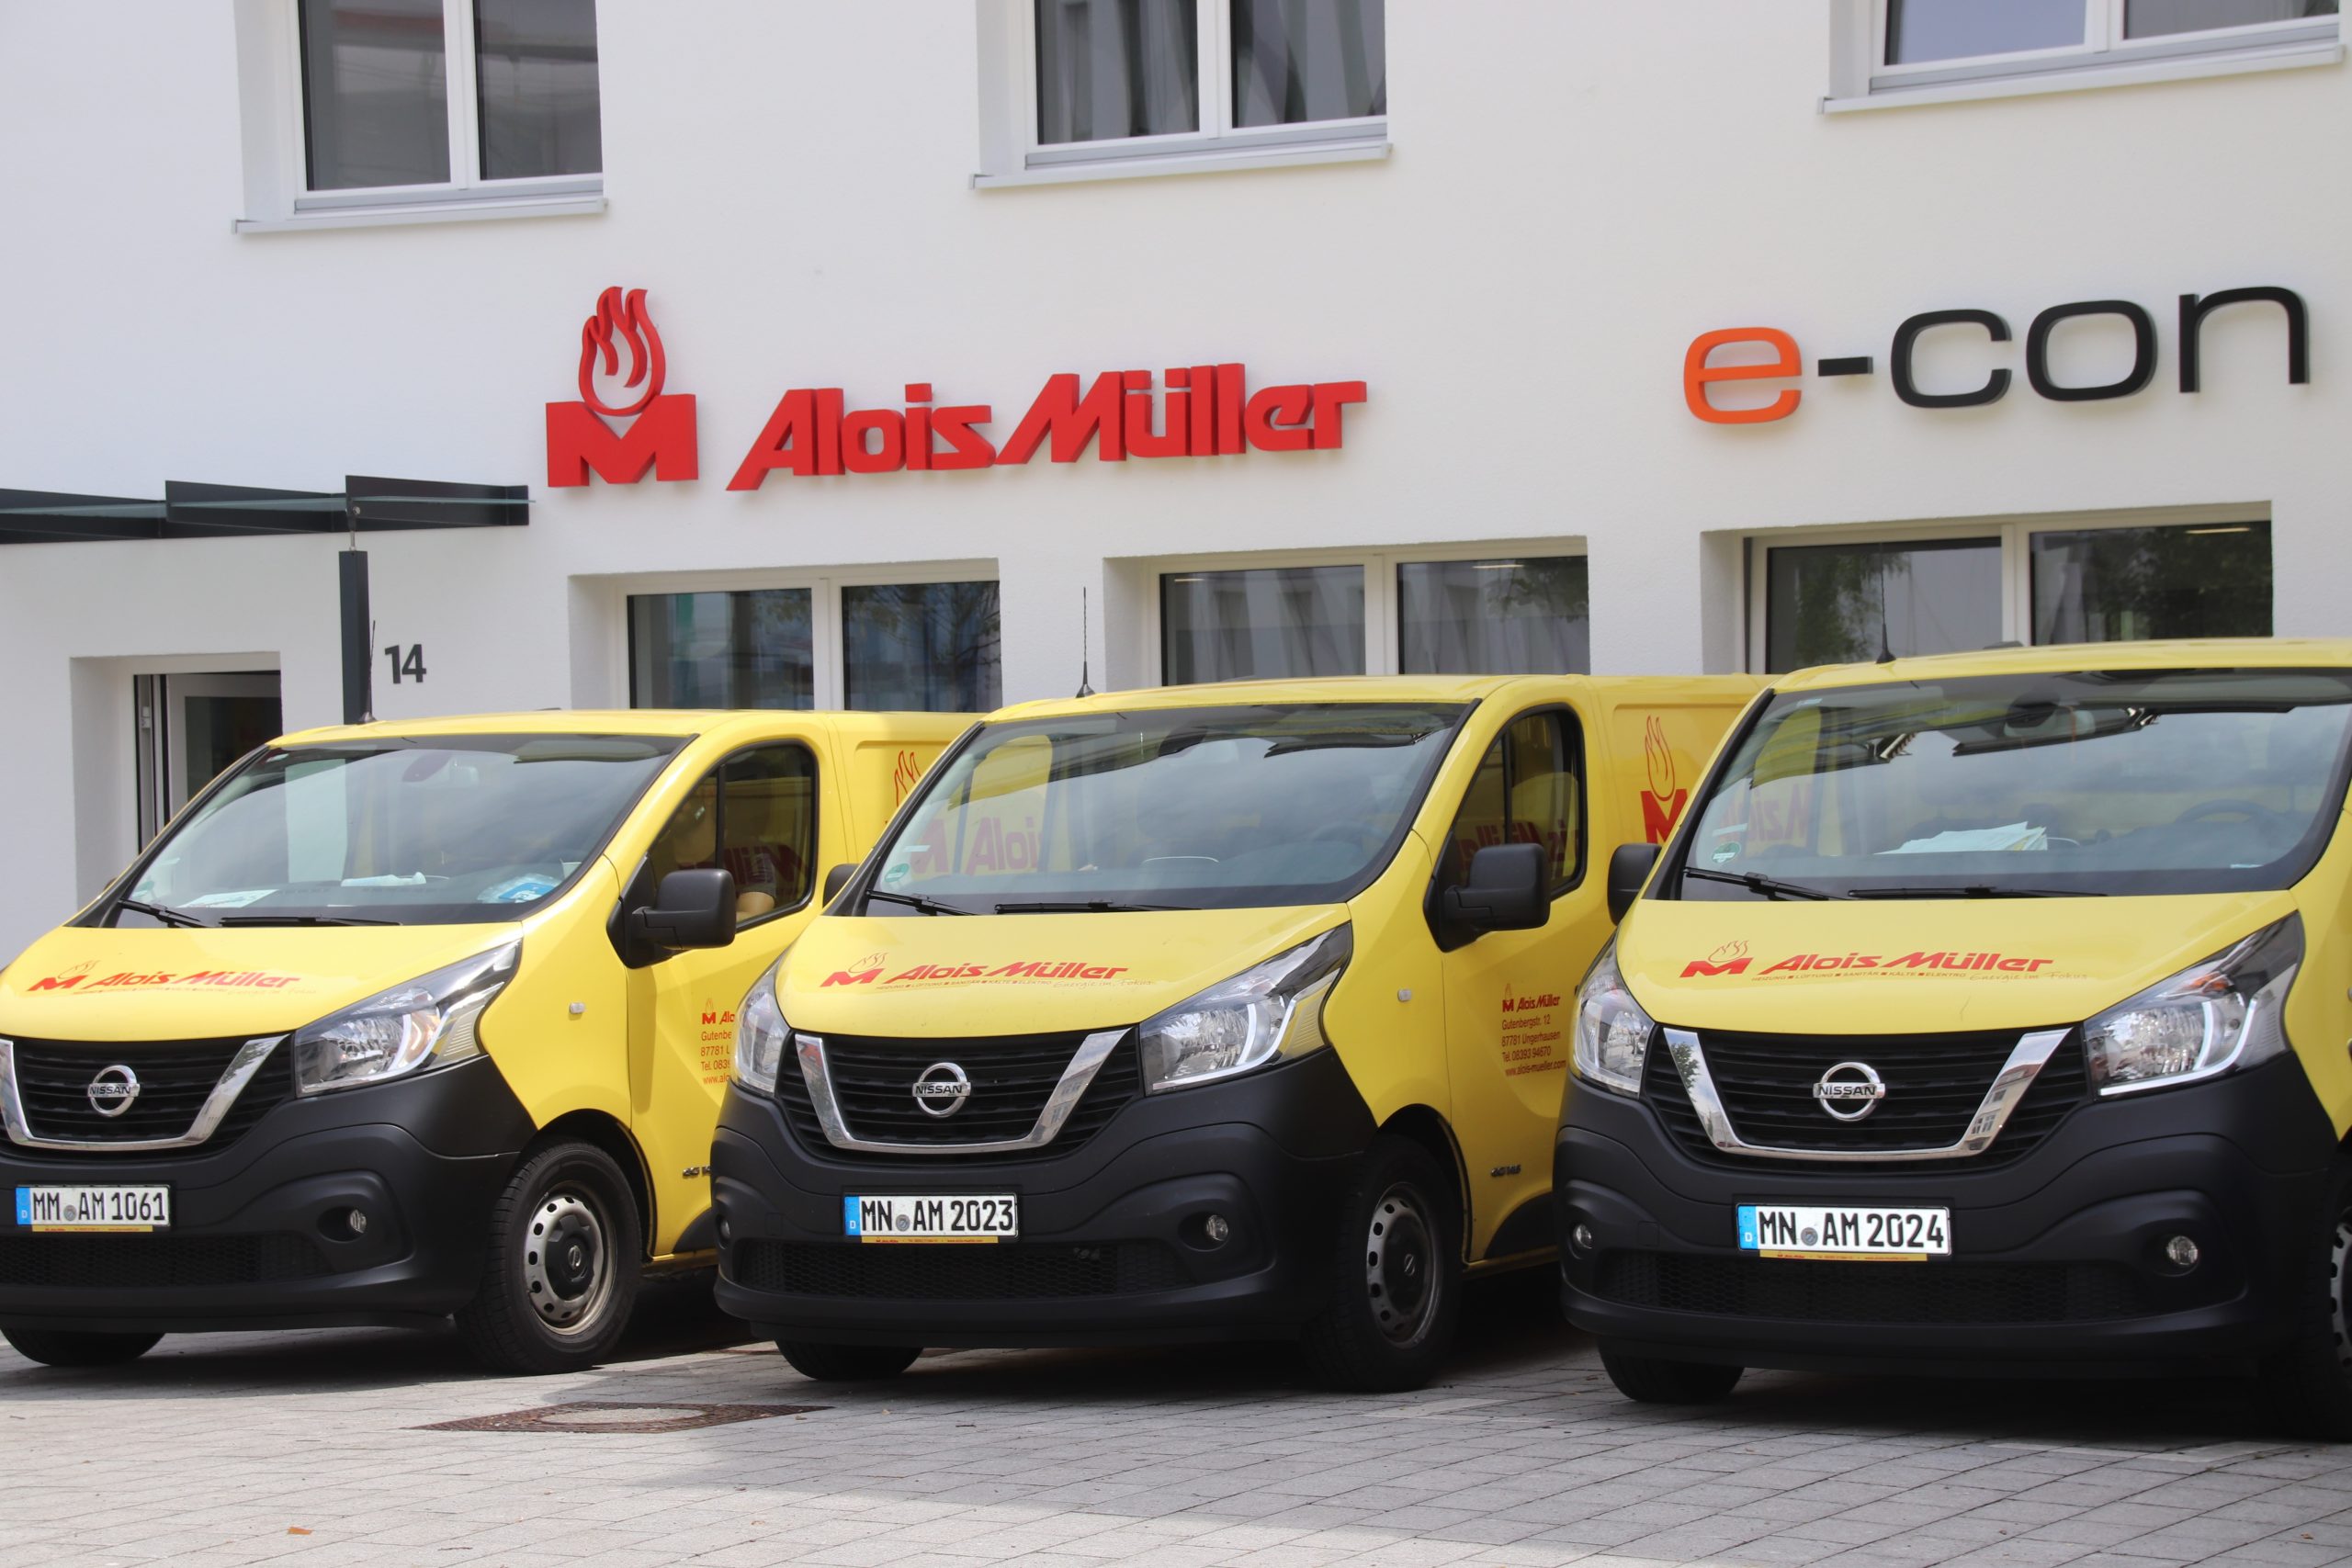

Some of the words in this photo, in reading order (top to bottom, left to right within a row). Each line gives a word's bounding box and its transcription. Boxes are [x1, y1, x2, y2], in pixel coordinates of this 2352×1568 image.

[1683, 286, 2309, 424] e-con
[547, 393, 698, 488] M
[384, 644, 426, 684] 14
[965, 816, 1044, 876] Aloi
[820, 968, 885, 988] M
[882, 963, 989, 985] Alois
[989, 961, 1129, 980] Müller
[1679, 958, 1753, 978] M
[1756, 952, 1883, 976] Alois
[1882, 952, 2054, 973] Müller
[28, 975, 87, 992] M
[83, 971, 175, 989] Alois
[175, 970, 301, 988] Müller
[1502, 998, 1514, 1012] M
[1516, 997, 1536, 1013] Alois
[1535, 993, 1561, 1009] Müller
[701, 1011, 716, 1025] M
[1543, 1014, 1551, 1025] 12
[700, 1045, 723, 1057] 87781
[1501, 1034, 1521, 1047] 87781
[1521, 1031, 1561, 1045] Ungerhausen
[89, 1085, 132, 1095] NISSAN
[915, 1084, 964, 1095] NISSAN
[1818, 1085, 1877, 1096] NISSAN
[33, 1192, 60, 1221] MM
[79, 1192, 105, 1221] AM
[111, 1191, 166, 1221] 1061
[861, 1201, 892, 1231] MN
[912, 1201, 944, 1231] AM
[950, 1200, 1013, 1231] 2023
[1758, 1212, 1797, 1246] MN
[1822, 1212, 1861, 1247] AM
[1866, 1213, 1945, 1248] 2024
